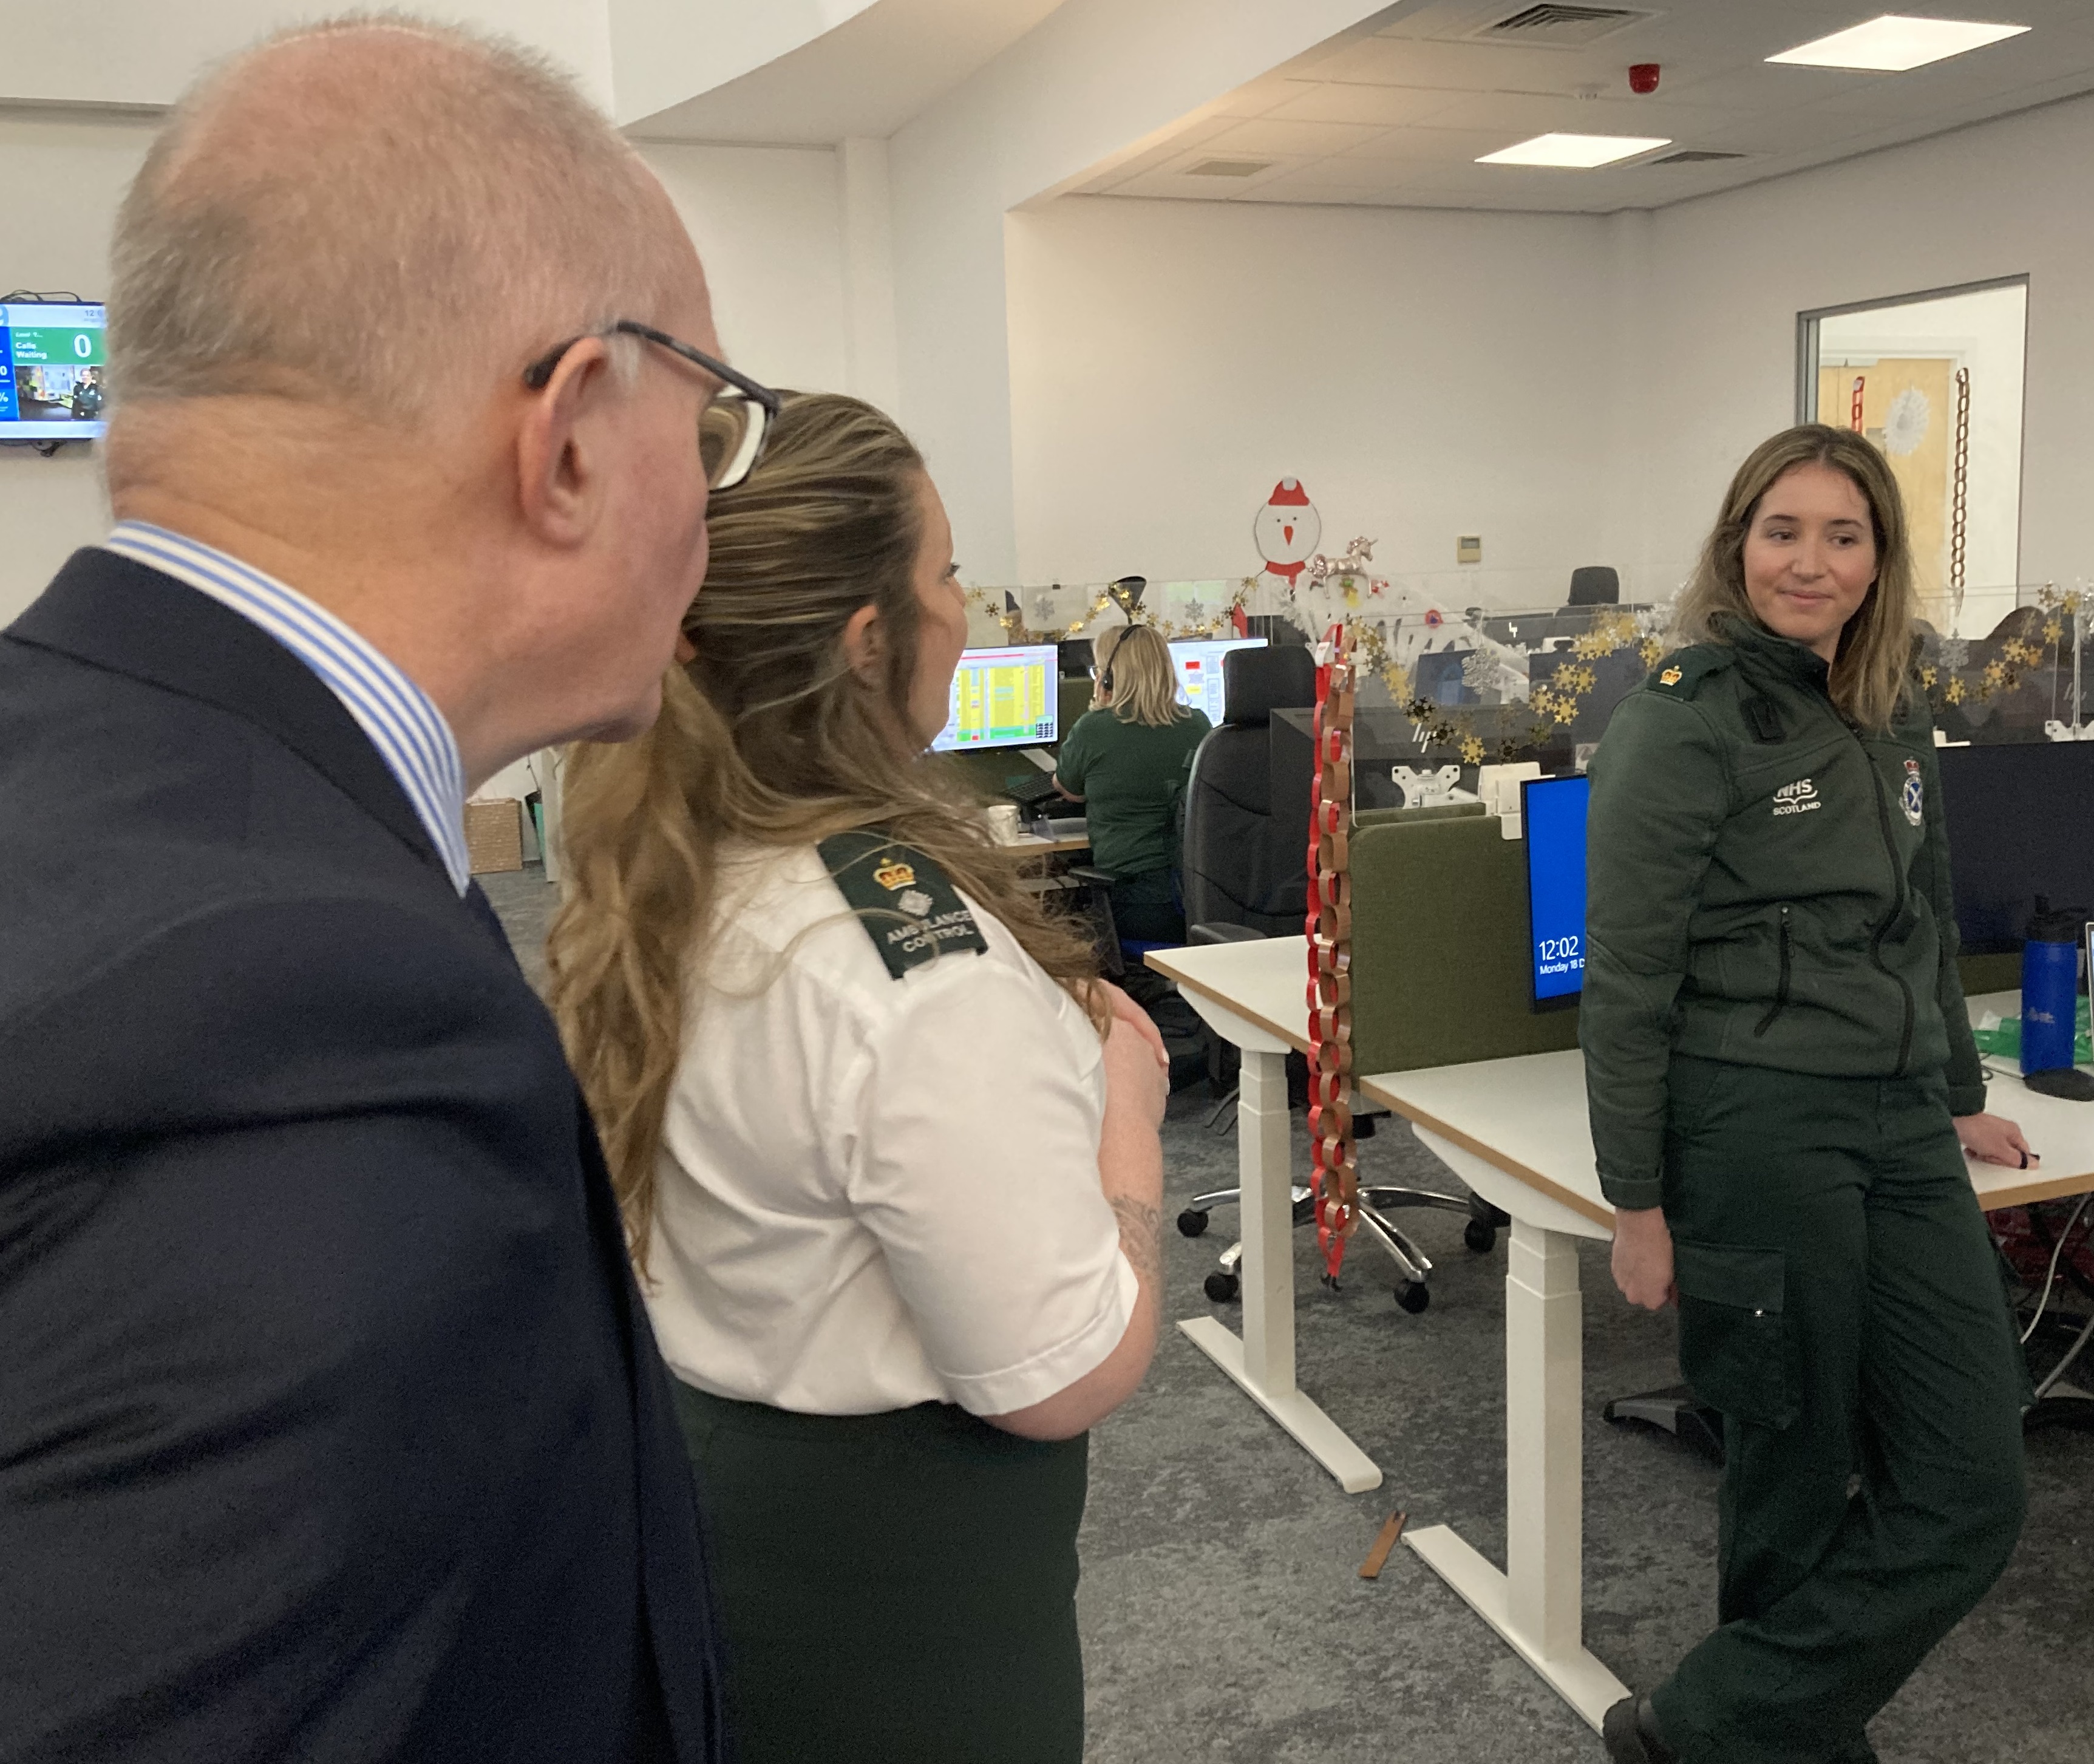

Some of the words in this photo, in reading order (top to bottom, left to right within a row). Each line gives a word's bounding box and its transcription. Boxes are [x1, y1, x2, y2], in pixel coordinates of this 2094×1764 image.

[16, 350, 47, 360] Waiting
[73, 334, 92, 358] 0
[1776, 778, 1812, 798] NHS
[1773, 801, 1821, 816] SCOTLAND
[1539, 936, 1579, 961] 12:02
[1540, 962, 1569, 975] Monday
[1570, 959, 1578, 970] 18
